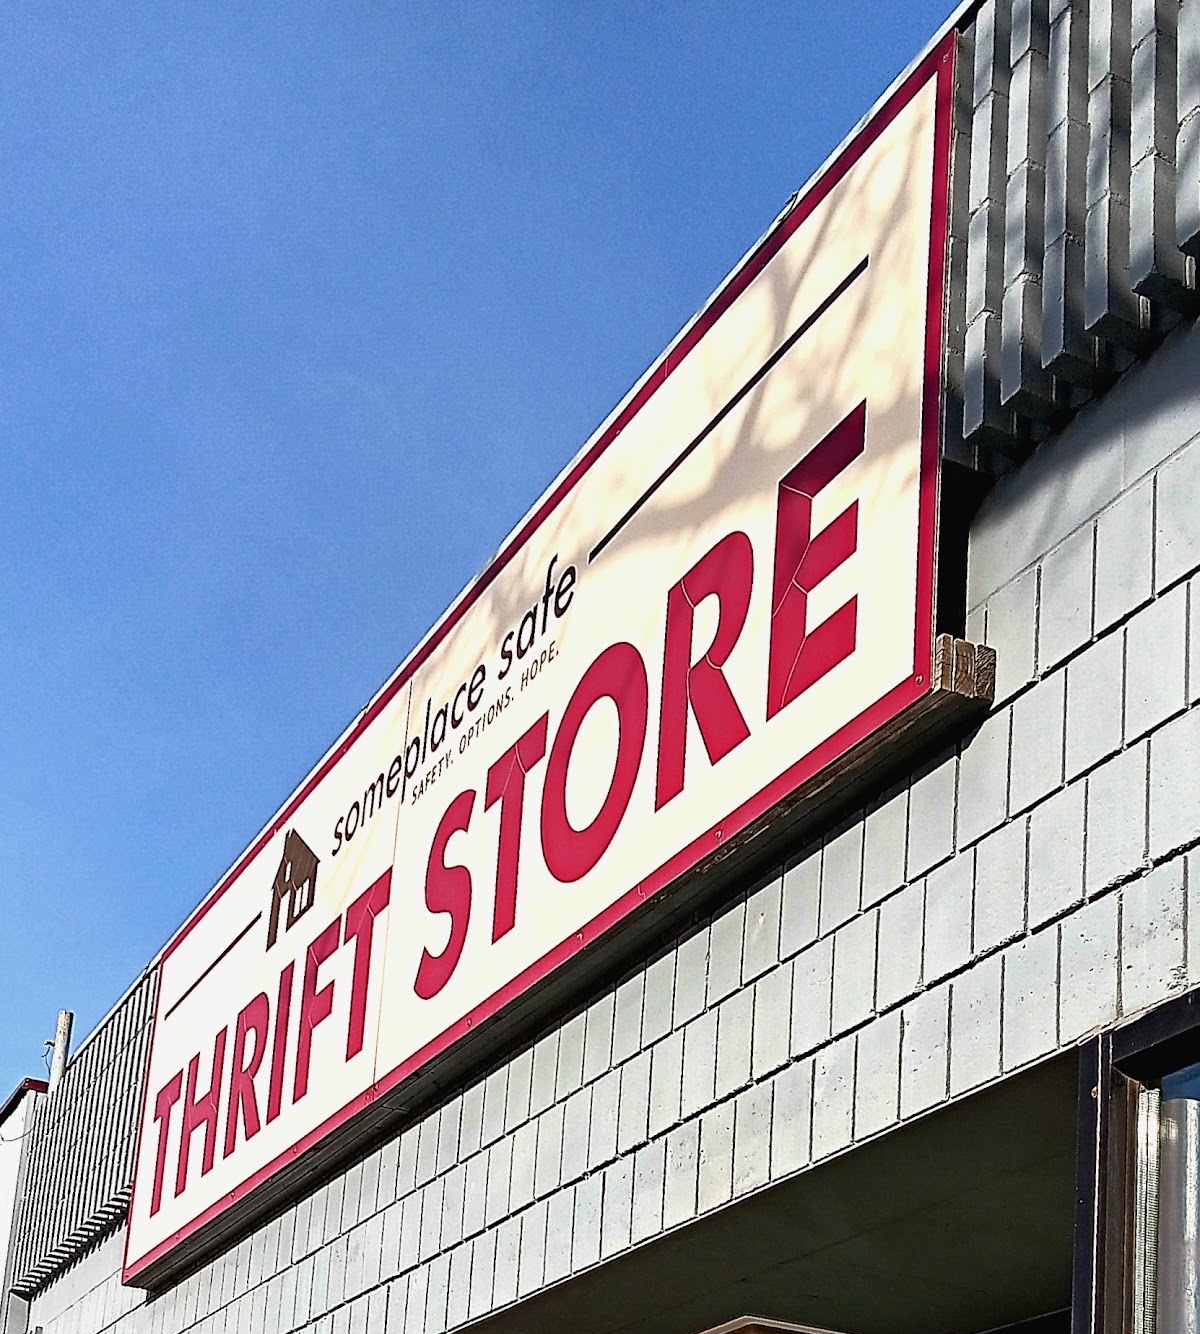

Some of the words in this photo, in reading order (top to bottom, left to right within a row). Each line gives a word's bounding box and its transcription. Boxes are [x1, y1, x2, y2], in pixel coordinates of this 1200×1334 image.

[149, 865, 393, 1218] THRIFT
[413, 397, 868, 1001] STORE
[331, 663, 487, 857] someplace
[498, 553, 577, 681] safe
[411, 748, 454, 806] SAFETY.
[458, 686, 515, 755] OPTIONS.
[520, 639, 560, 692] HOPE.
